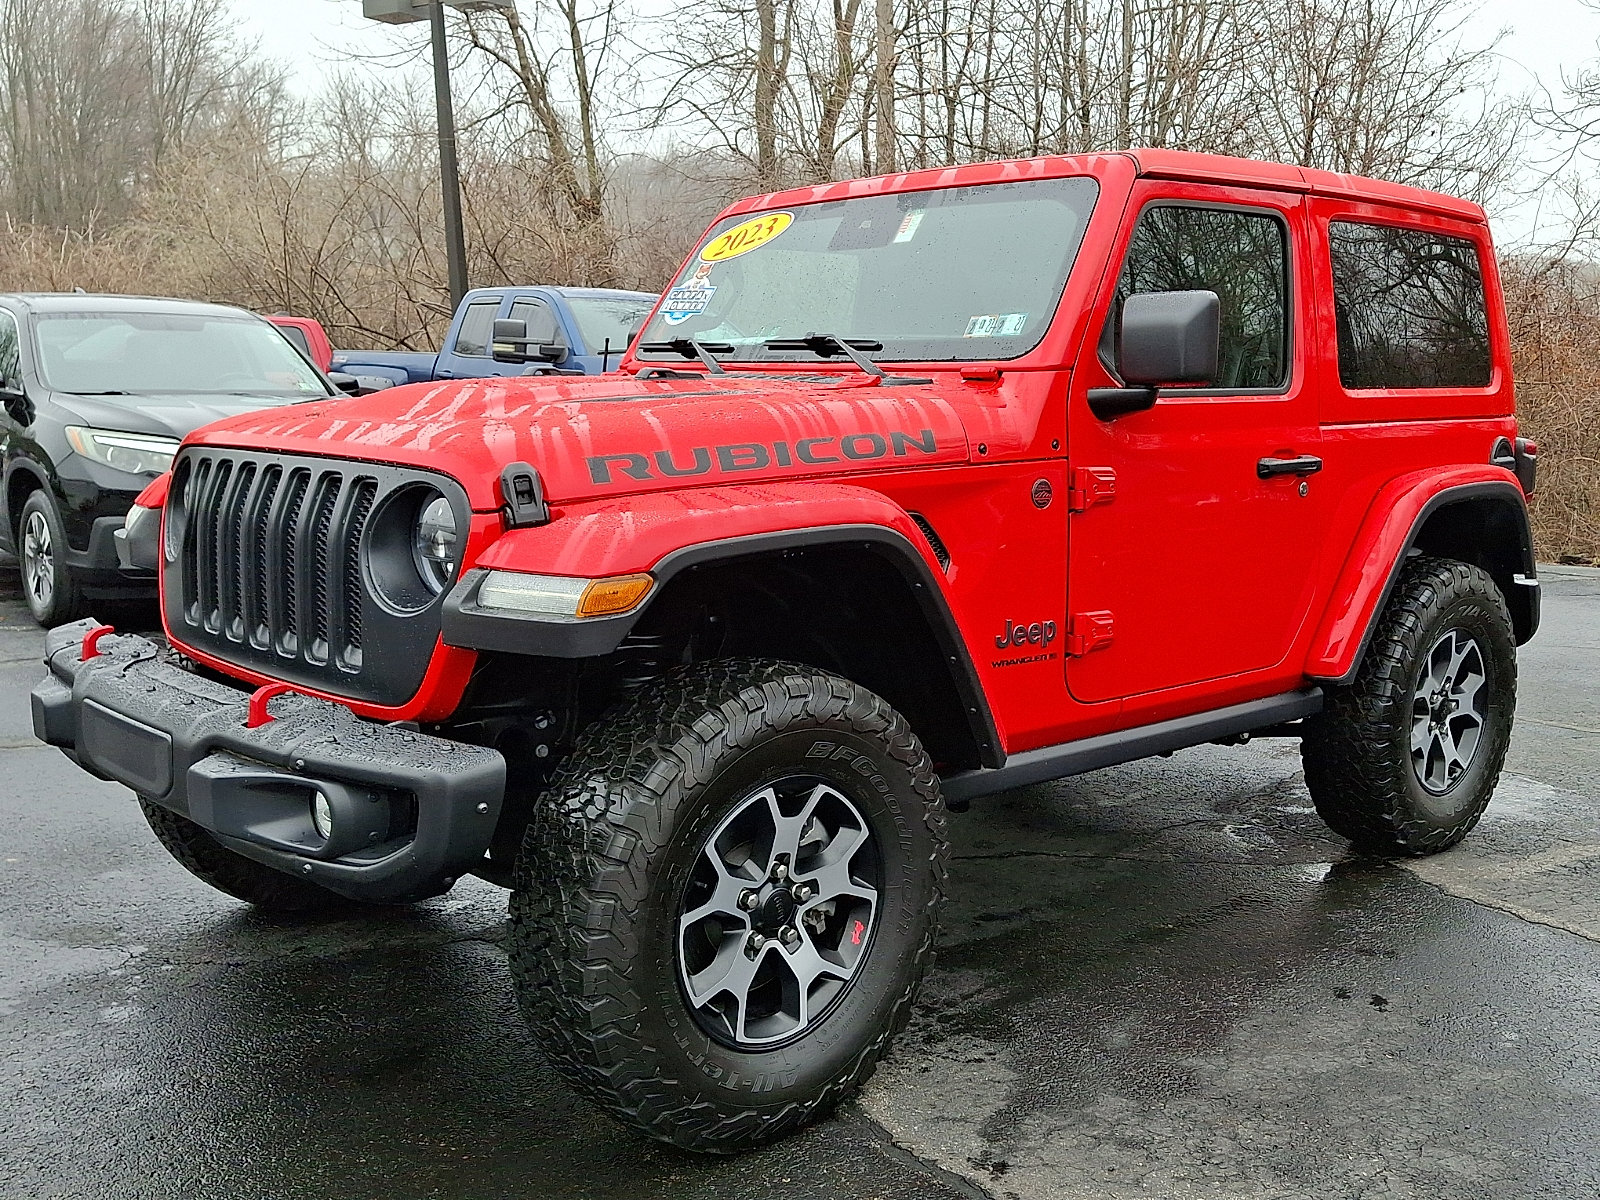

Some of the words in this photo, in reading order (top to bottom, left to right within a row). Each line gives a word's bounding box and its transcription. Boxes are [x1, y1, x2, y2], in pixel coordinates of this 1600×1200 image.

[712, 217, 779, 258] 2023
[585, 429, 938, 485] RUBICON
[995, 618, 1057, 649] Jeep
[992, 654, 1052, 669] WRANGLER
